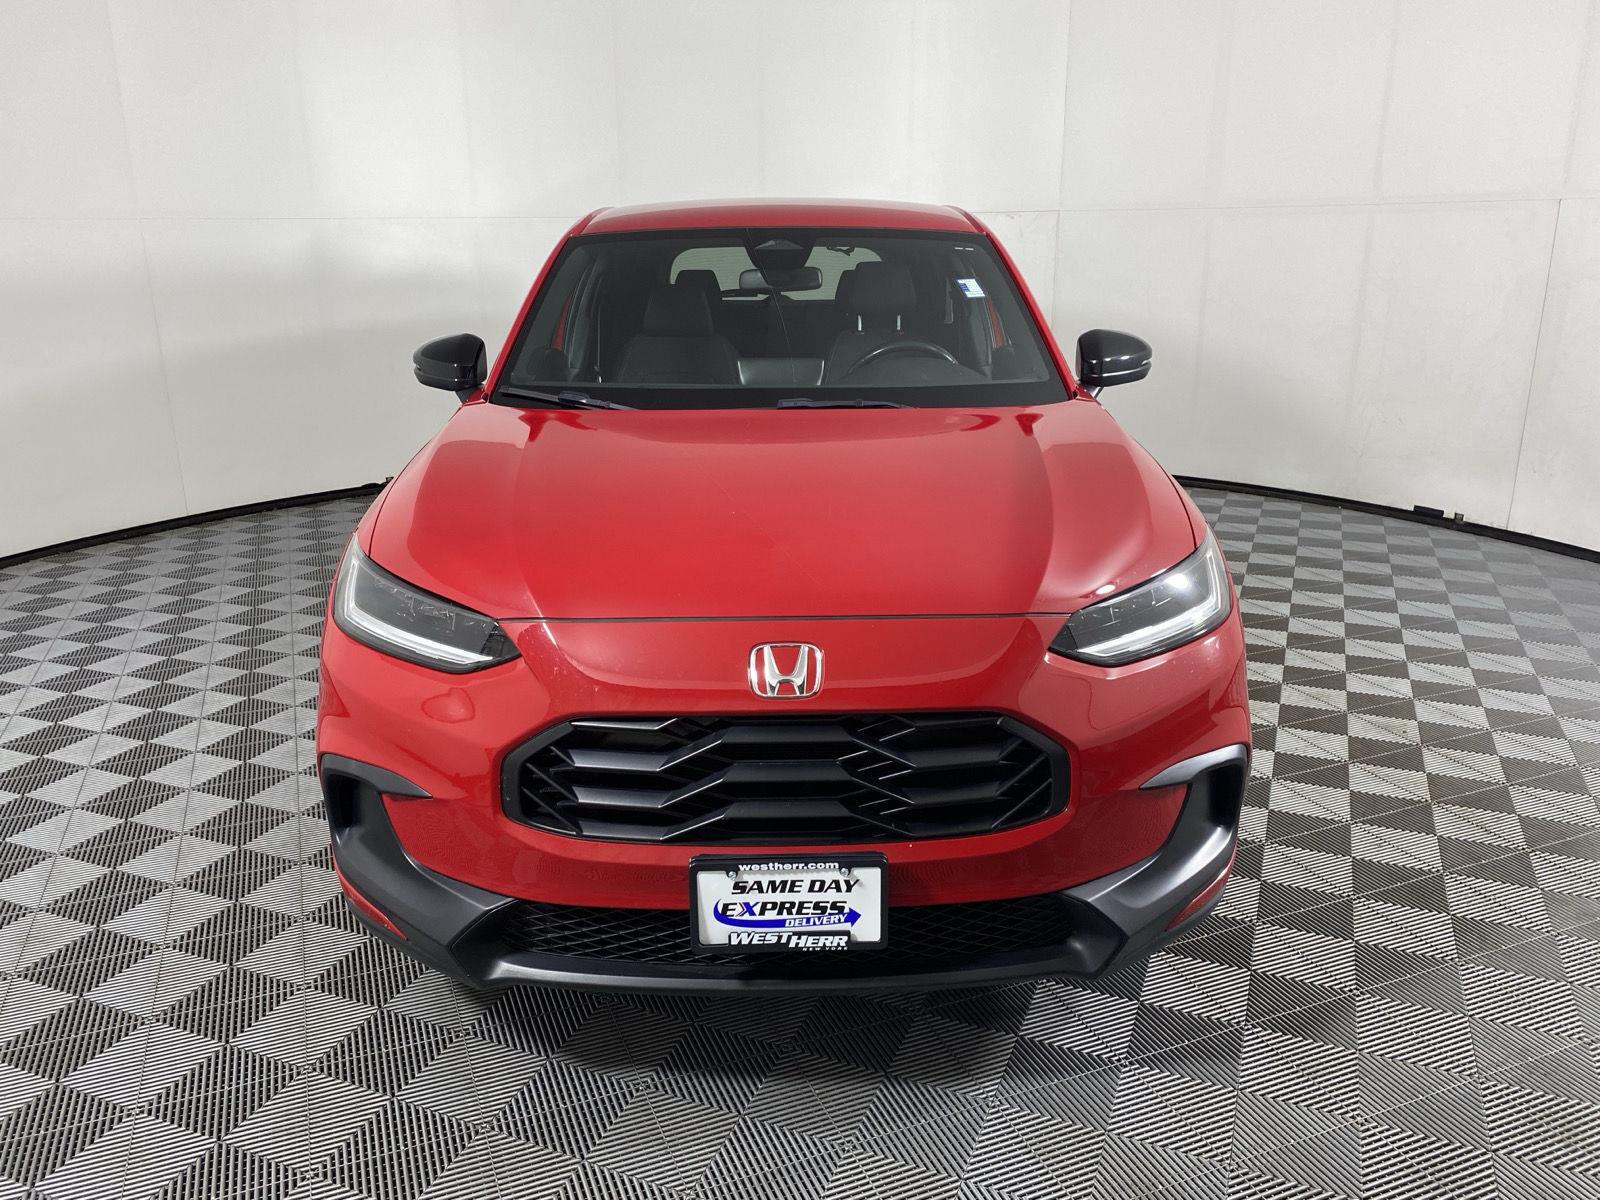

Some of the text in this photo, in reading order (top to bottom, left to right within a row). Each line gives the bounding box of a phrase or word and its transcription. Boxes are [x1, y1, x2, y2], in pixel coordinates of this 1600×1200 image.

[738, 862, 839, 871] westherr.com
[731, 879, 860, 894] SAME DAY
[720, 901, 847, 917] EXPRESS
[785, 914, 848, 927] DELIVERY
